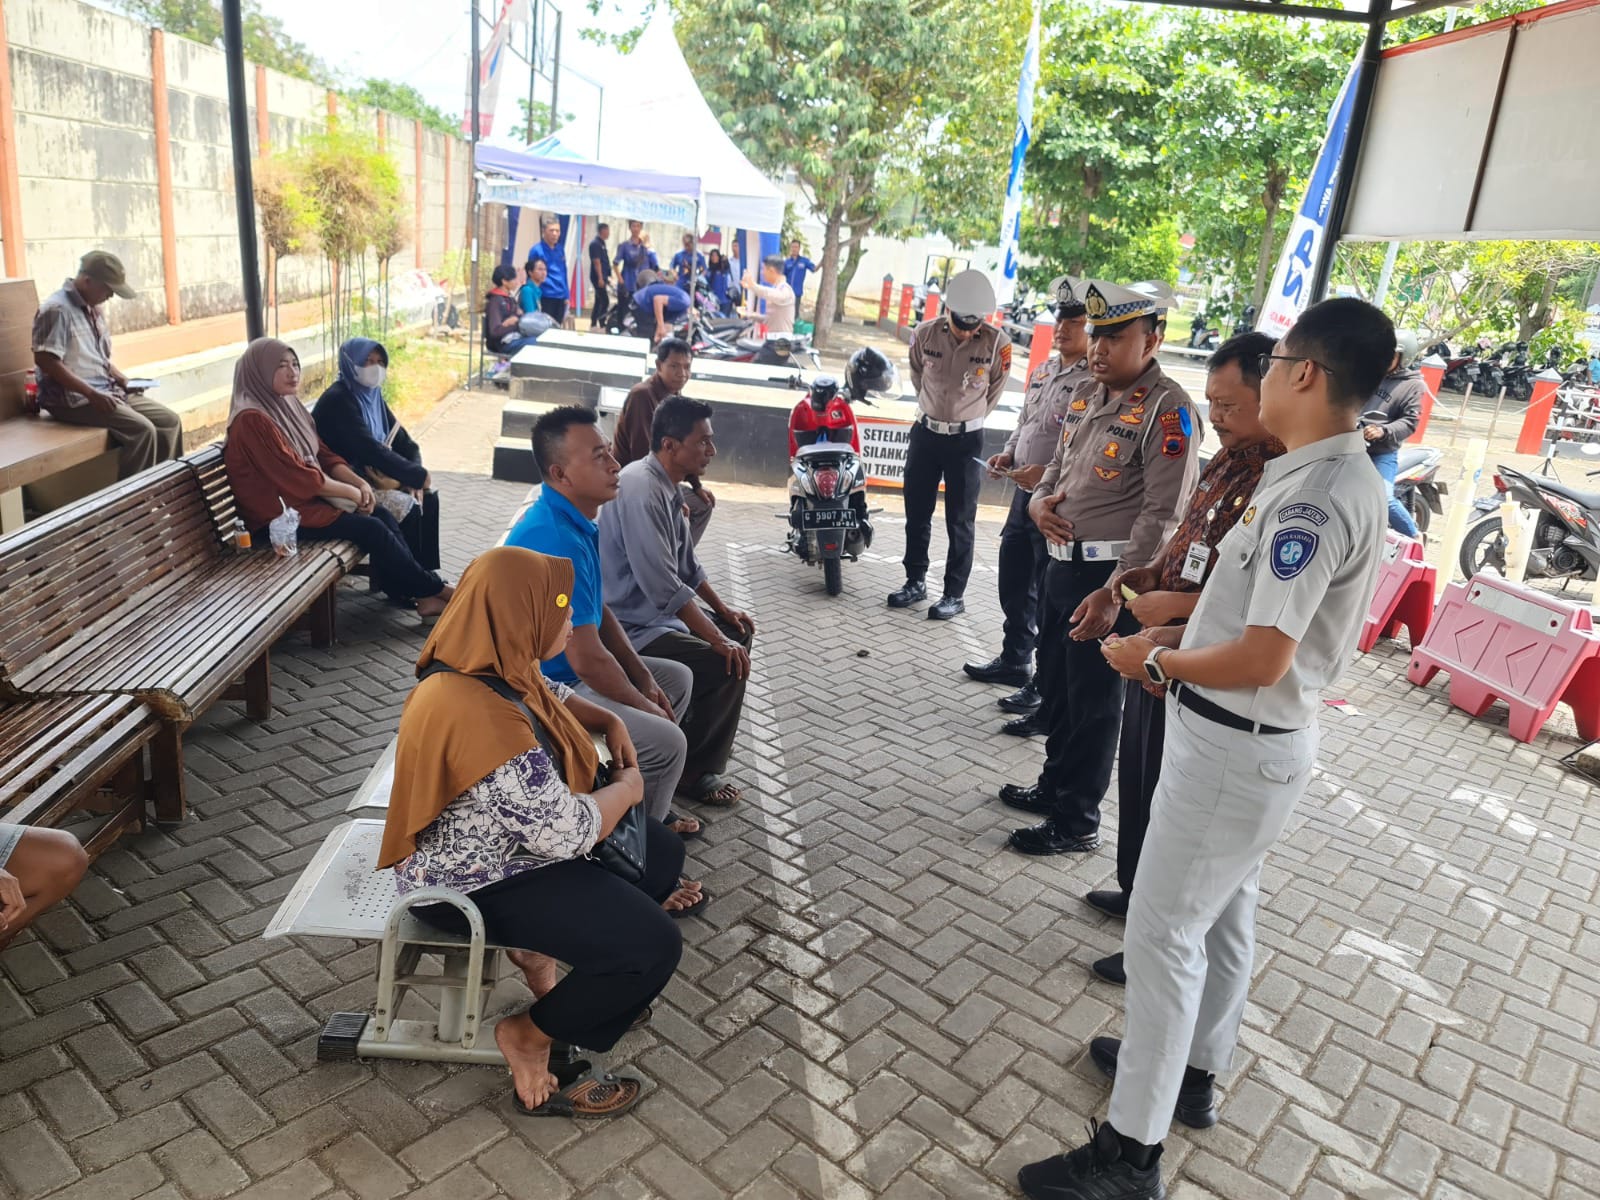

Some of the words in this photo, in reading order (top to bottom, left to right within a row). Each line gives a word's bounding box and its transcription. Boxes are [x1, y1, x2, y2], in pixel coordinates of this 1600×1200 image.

[1106, 424, 1138, 442] POLRI
[862, 445, 908, 461] SILAHKA
[875, 464, 904, 478] TEMP
[816, 511, 837, 521] 5907
